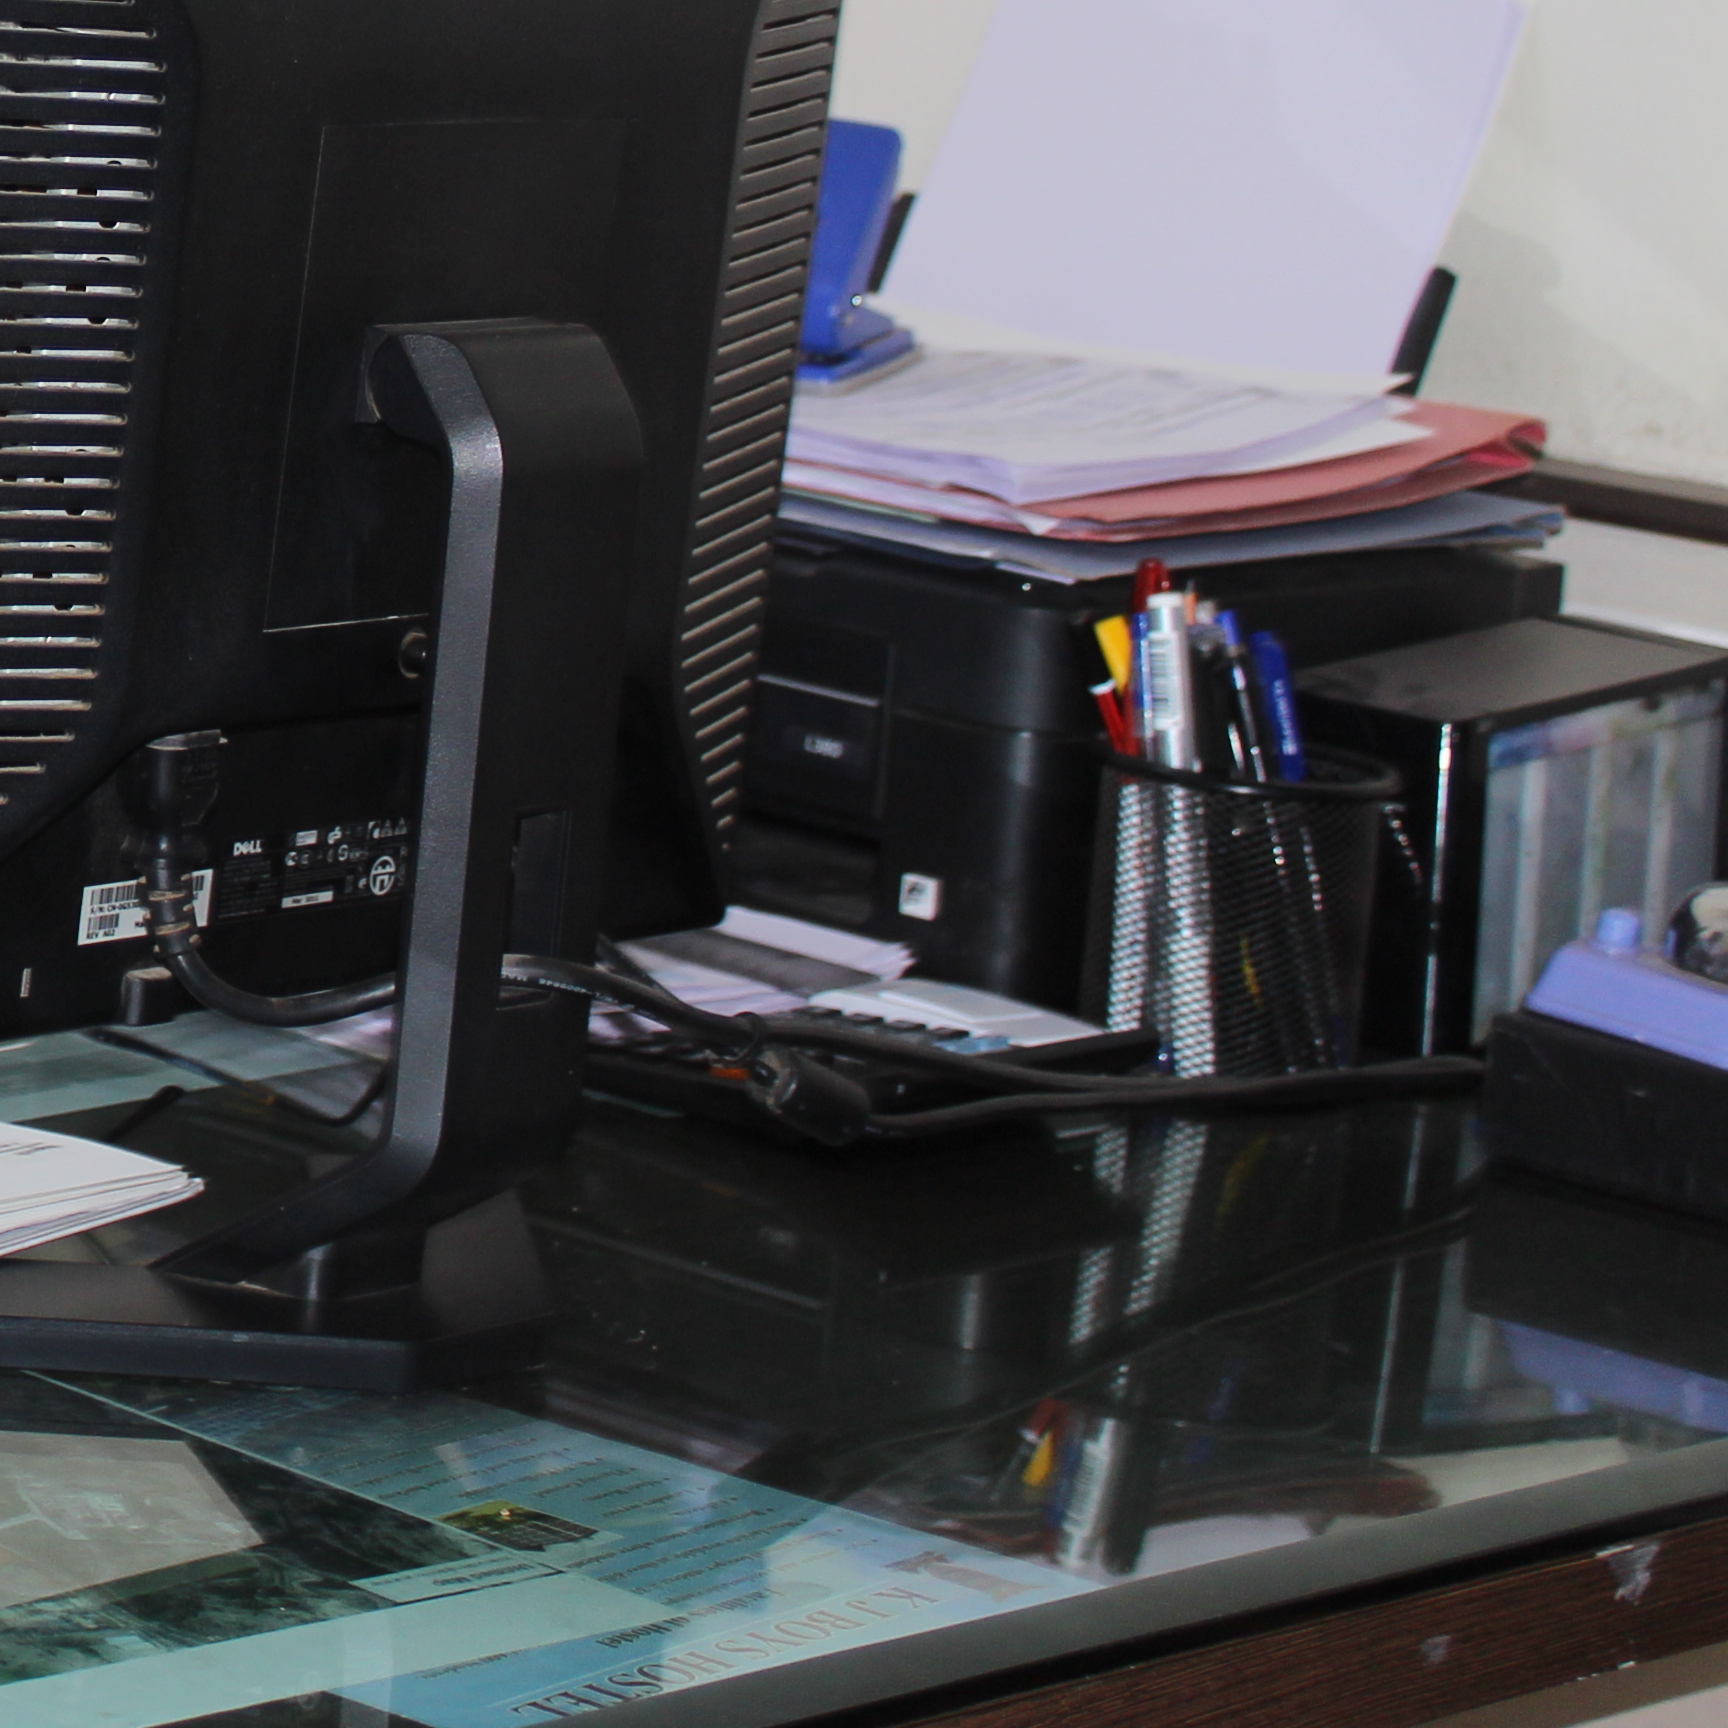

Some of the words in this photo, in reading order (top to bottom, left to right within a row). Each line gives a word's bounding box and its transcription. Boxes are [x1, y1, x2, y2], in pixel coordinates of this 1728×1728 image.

[232, 839, 263, 857] DELL
[846, 1599, 892, 1619] J
[873, 1585, 940, 1609] K
[594, 1622, 673, 1650] Hostel
[714, 1609, 845, 1660] BOYS
[510, 1649, 734, 1720] HOSTEL
